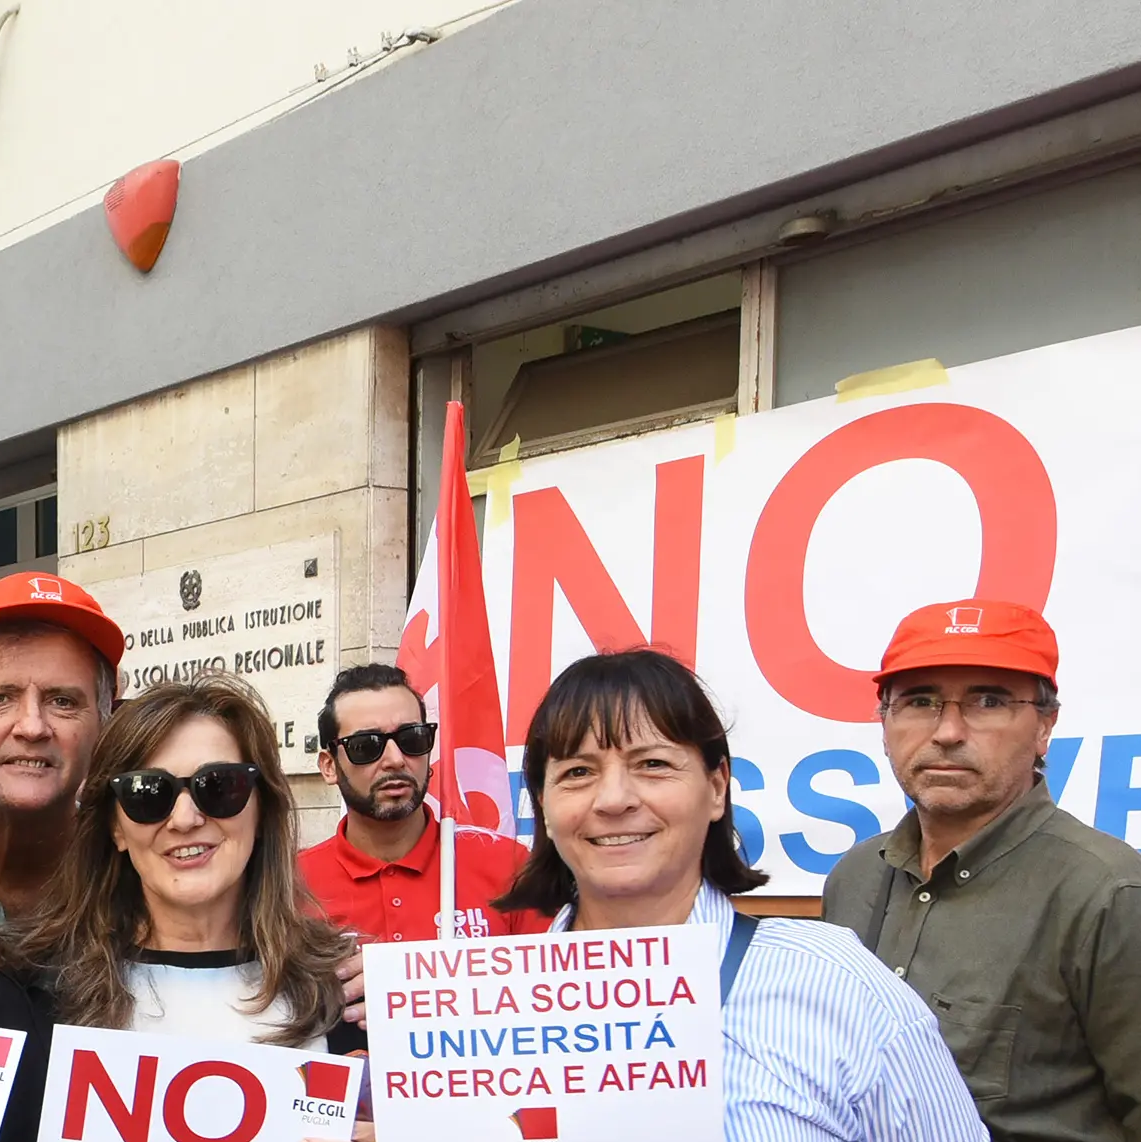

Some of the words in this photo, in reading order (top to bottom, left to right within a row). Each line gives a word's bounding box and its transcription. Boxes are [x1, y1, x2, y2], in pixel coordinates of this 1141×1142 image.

[71, 515, 110, 553] 123
[505, 402, 1057, 746] NO
[141, 627, 173, 648] DELLA
[182, 615, 235, 639] PUBBLICA
[244, 599, 322, 630] ISTRUZIONE
[234, 640, 325, 674] REGIONALE
[437, 925, 489, 939] ARI
[404, 936, 670, 980] INVESTIMENTI
[386, 988, 459, 1019] PER
[472, 986, 520, 1015] LA
[531, 976, 696, 1013] SCUOLA
[409, 1013, 676, 1059] UNIVERSITÁ
[385, 1067, 552, 1099] RICERCA
[563, 1065, 586, 1094] E
[598, 1059, 707, 1092] AFAM
[292, 1099, 315, 1113] FLC
[318, 1102, 346, 1119] CGIL
